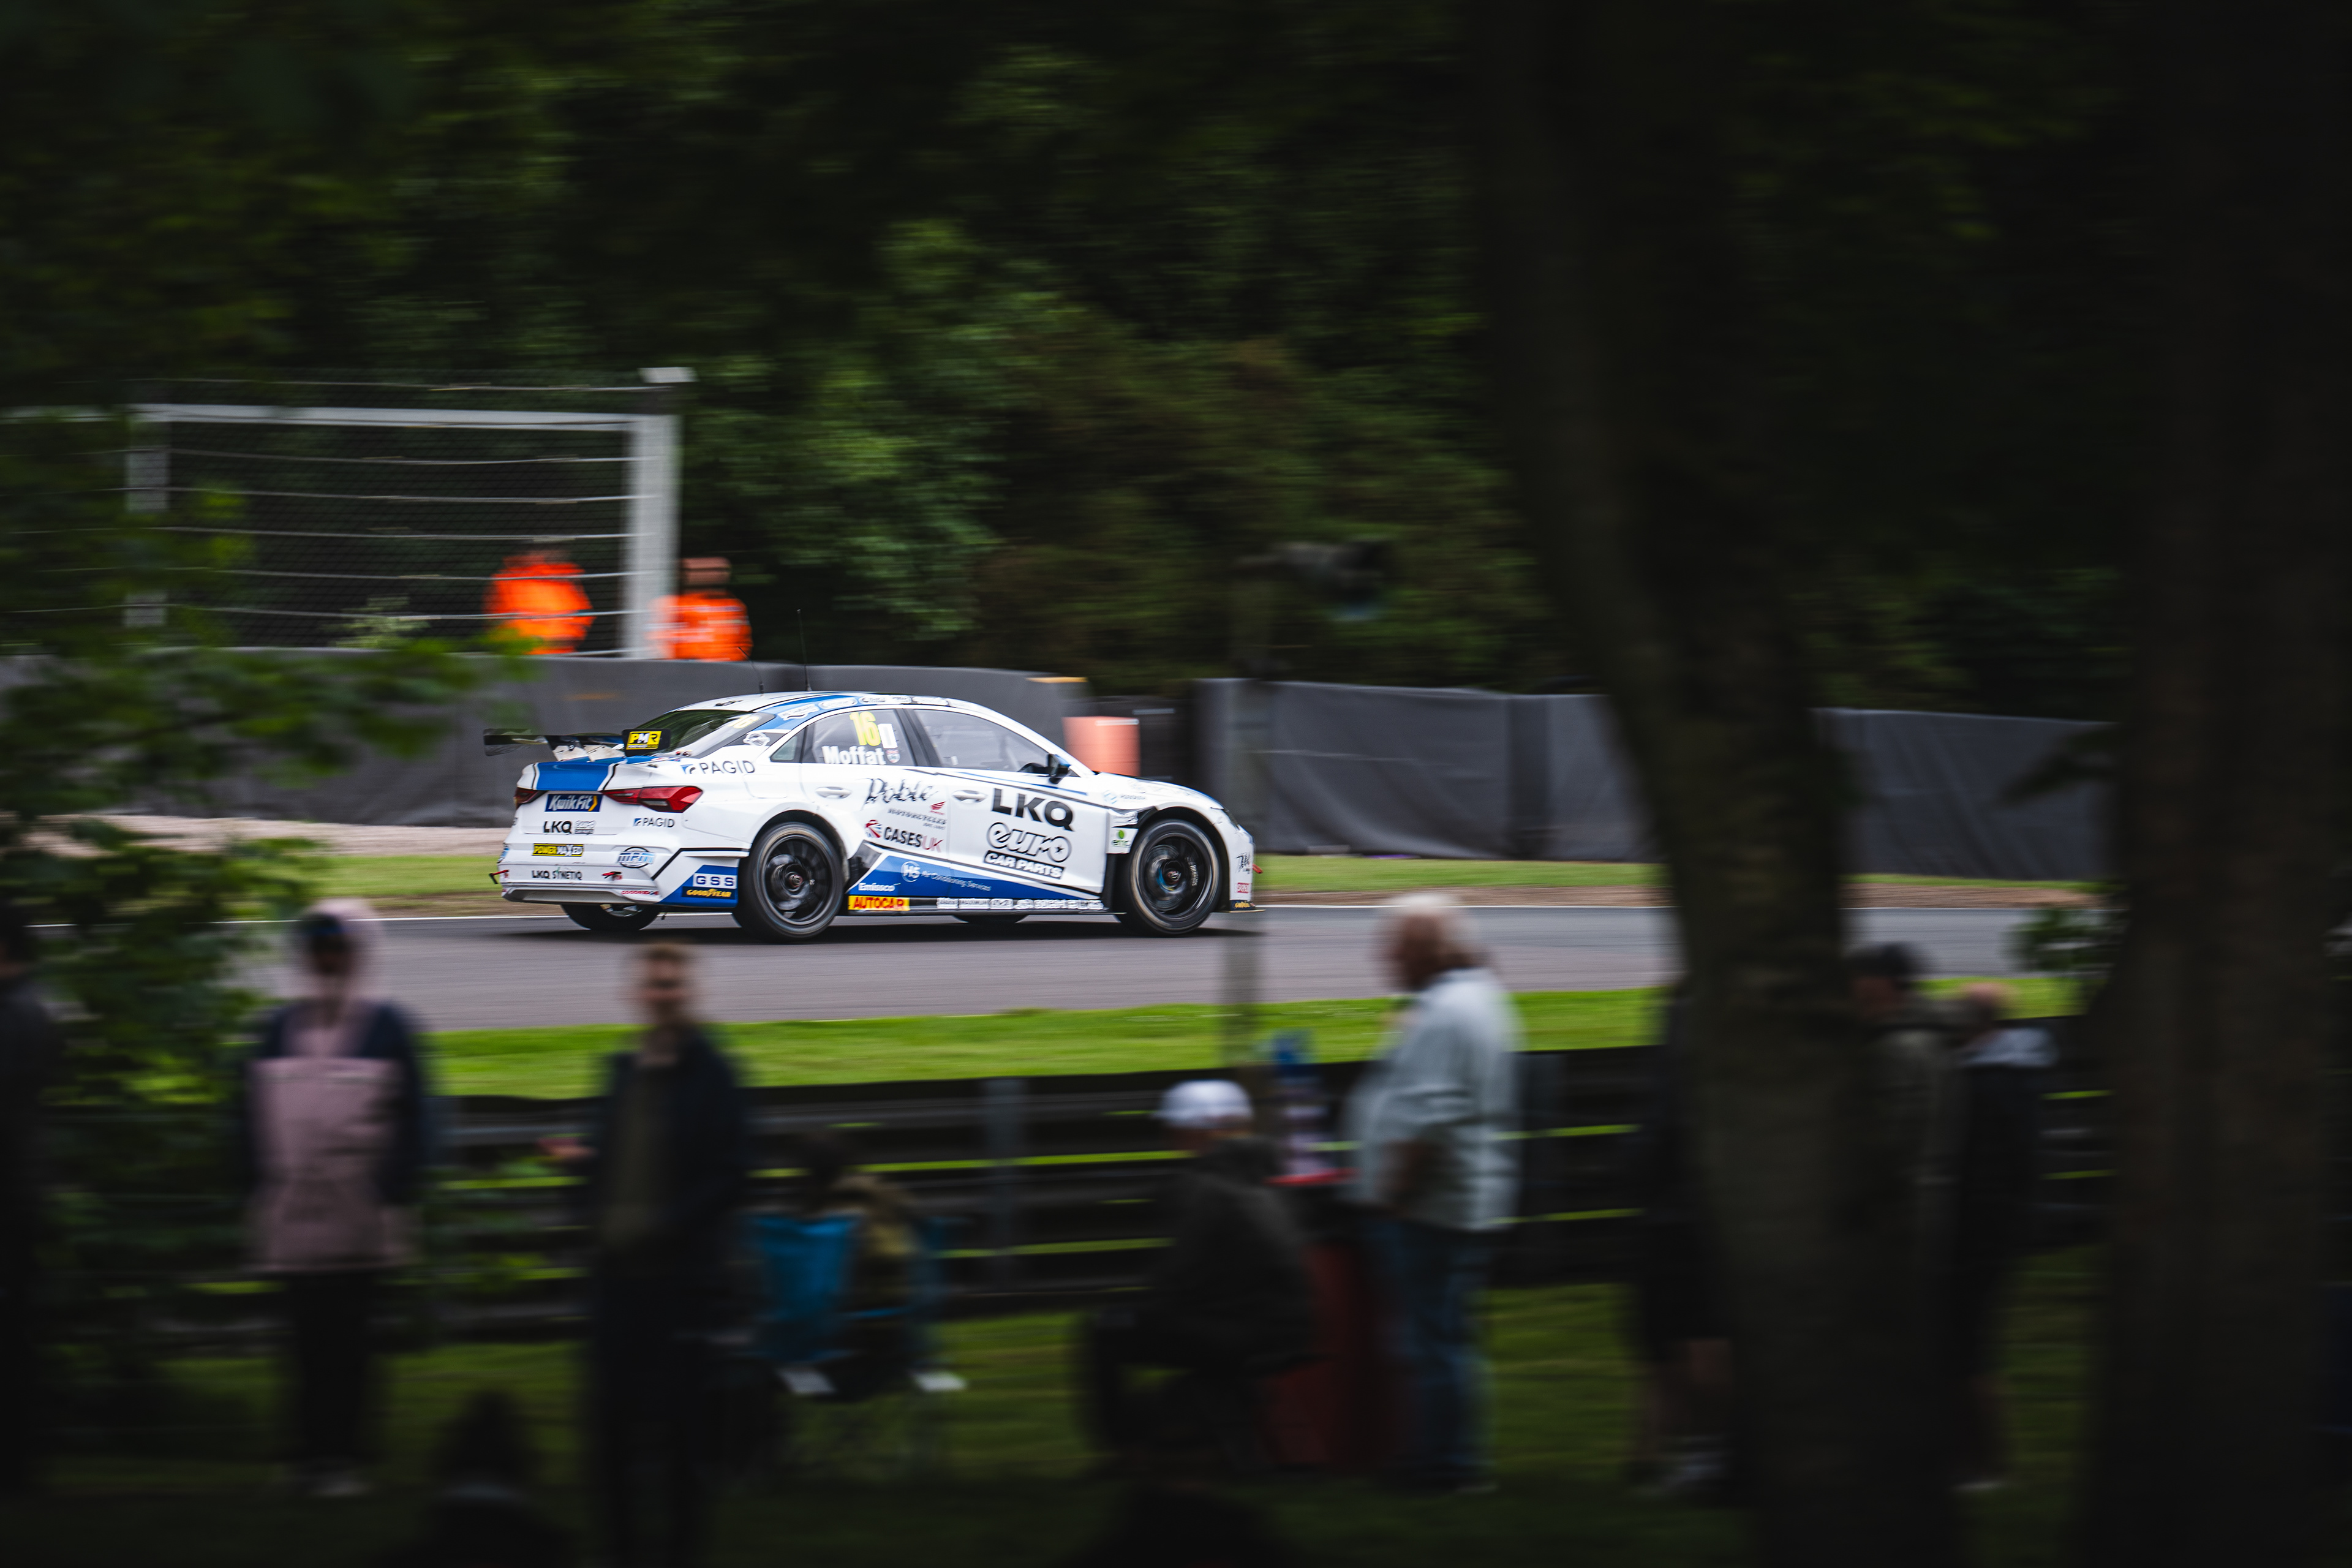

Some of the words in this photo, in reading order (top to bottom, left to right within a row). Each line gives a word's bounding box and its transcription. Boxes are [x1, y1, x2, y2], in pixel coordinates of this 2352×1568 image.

[850, 711, 881, 746] 16
[629, 733, 657, 744] PMR
[821, 745, 886, 765] Moffat
[699, 760, 755, 774] PAGID
[991, 788, 1075, 832] LKQ
[543, 821, 571, 834] LKQ
[643, 817, 675, 827] PAGID
[986, 822, 1072, 863] euro
[985, 853, 1016, 867] CAR
[1016, 859, 1063, 878] PARTS
[532, 870, 550, 880] LKQ
[854, 897, 905, 910] AUTOCAR
